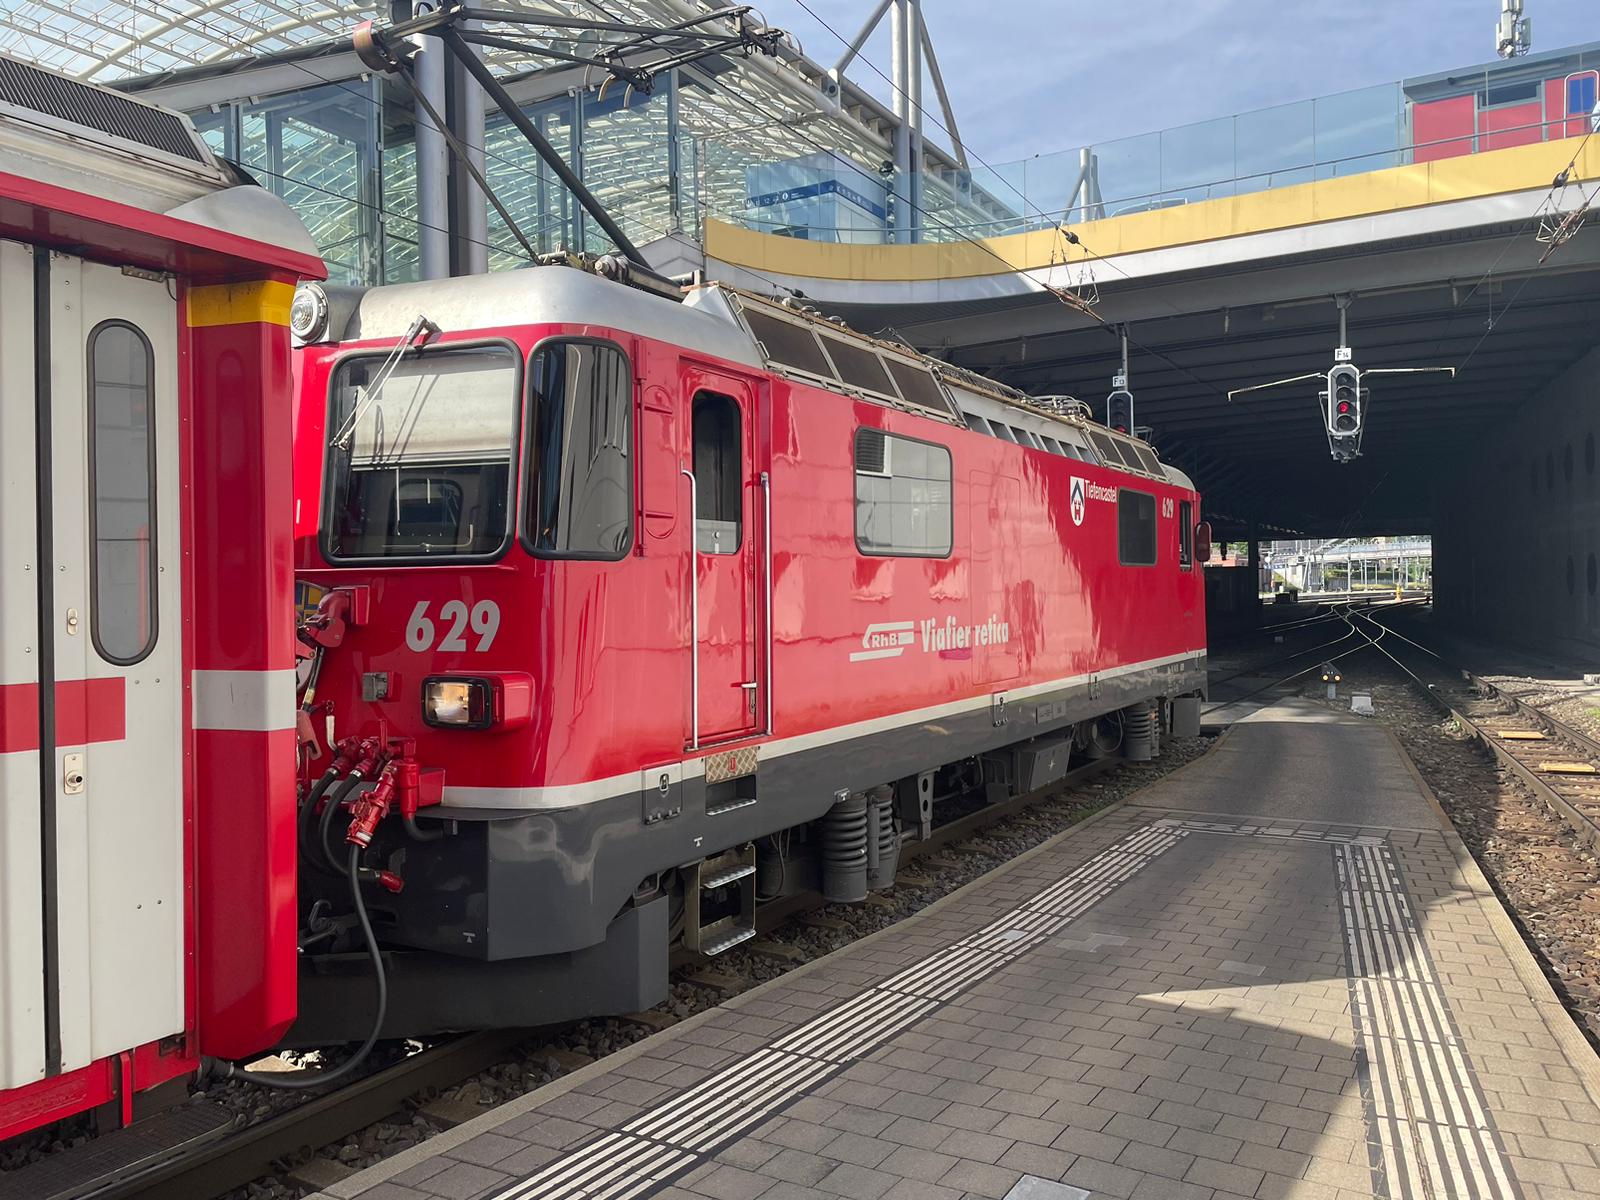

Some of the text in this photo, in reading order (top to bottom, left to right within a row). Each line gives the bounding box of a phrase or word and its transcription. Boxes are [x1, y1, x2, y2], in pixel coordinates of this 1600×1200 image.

[1084, 479, 1118, 503] Tiefencastel
[1162, 496, 1174, 519] 629
[405, 599, 501, 653] 629
[920, 613, 1009, 653] Viafier retica
[871, 632, 899, 648] RhB
